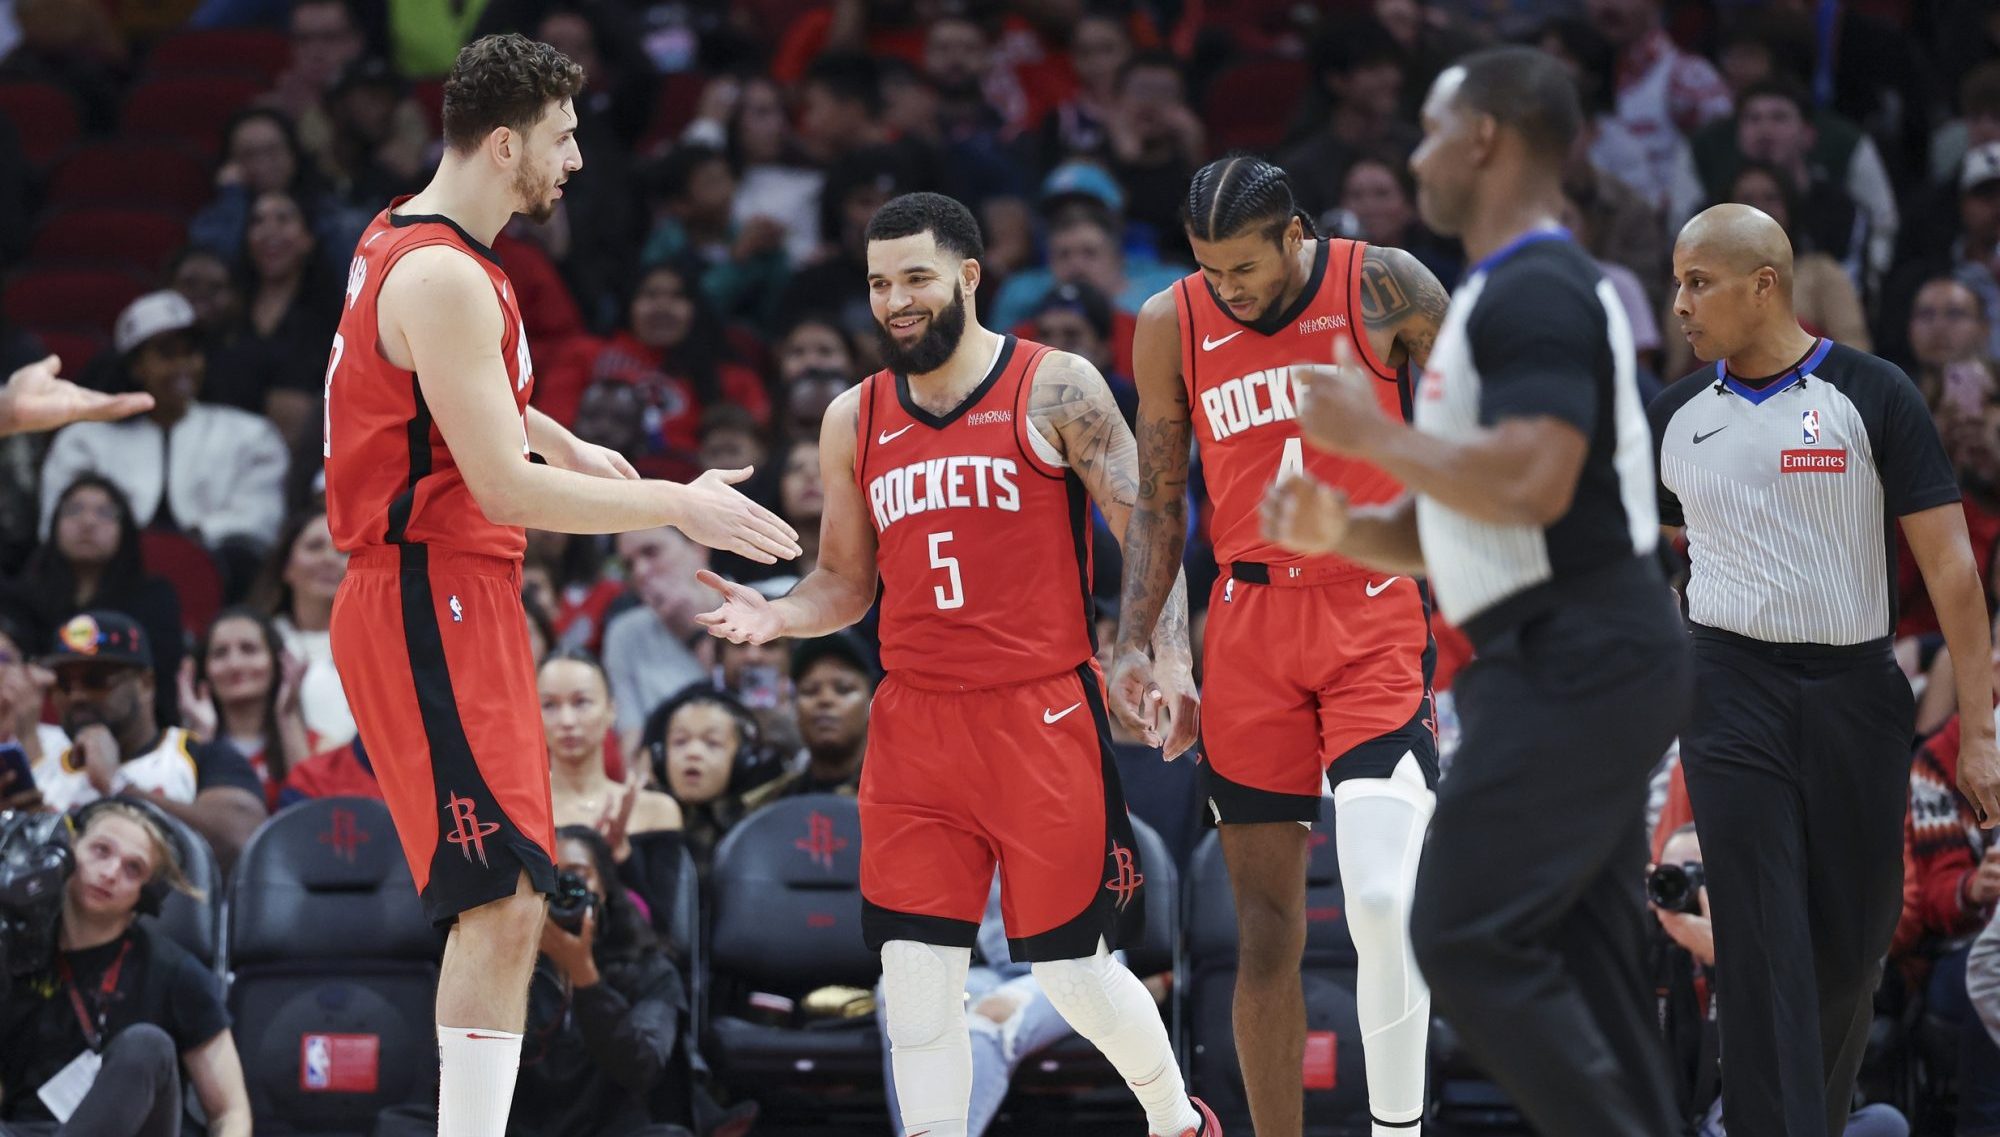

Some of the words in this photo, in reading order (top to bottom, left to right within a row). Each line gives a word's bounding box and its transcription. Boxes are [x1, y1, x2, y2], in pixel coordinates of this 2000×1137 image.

[1299, 314, 1346, 328] MEMORIAL
[1300, 319, 1346, 334] HERMANN
[1783, 453, 1845, 468] Emirates
[869, 455, 1021, 534] ROCKETS
[927, 530, 965, 610] 5
